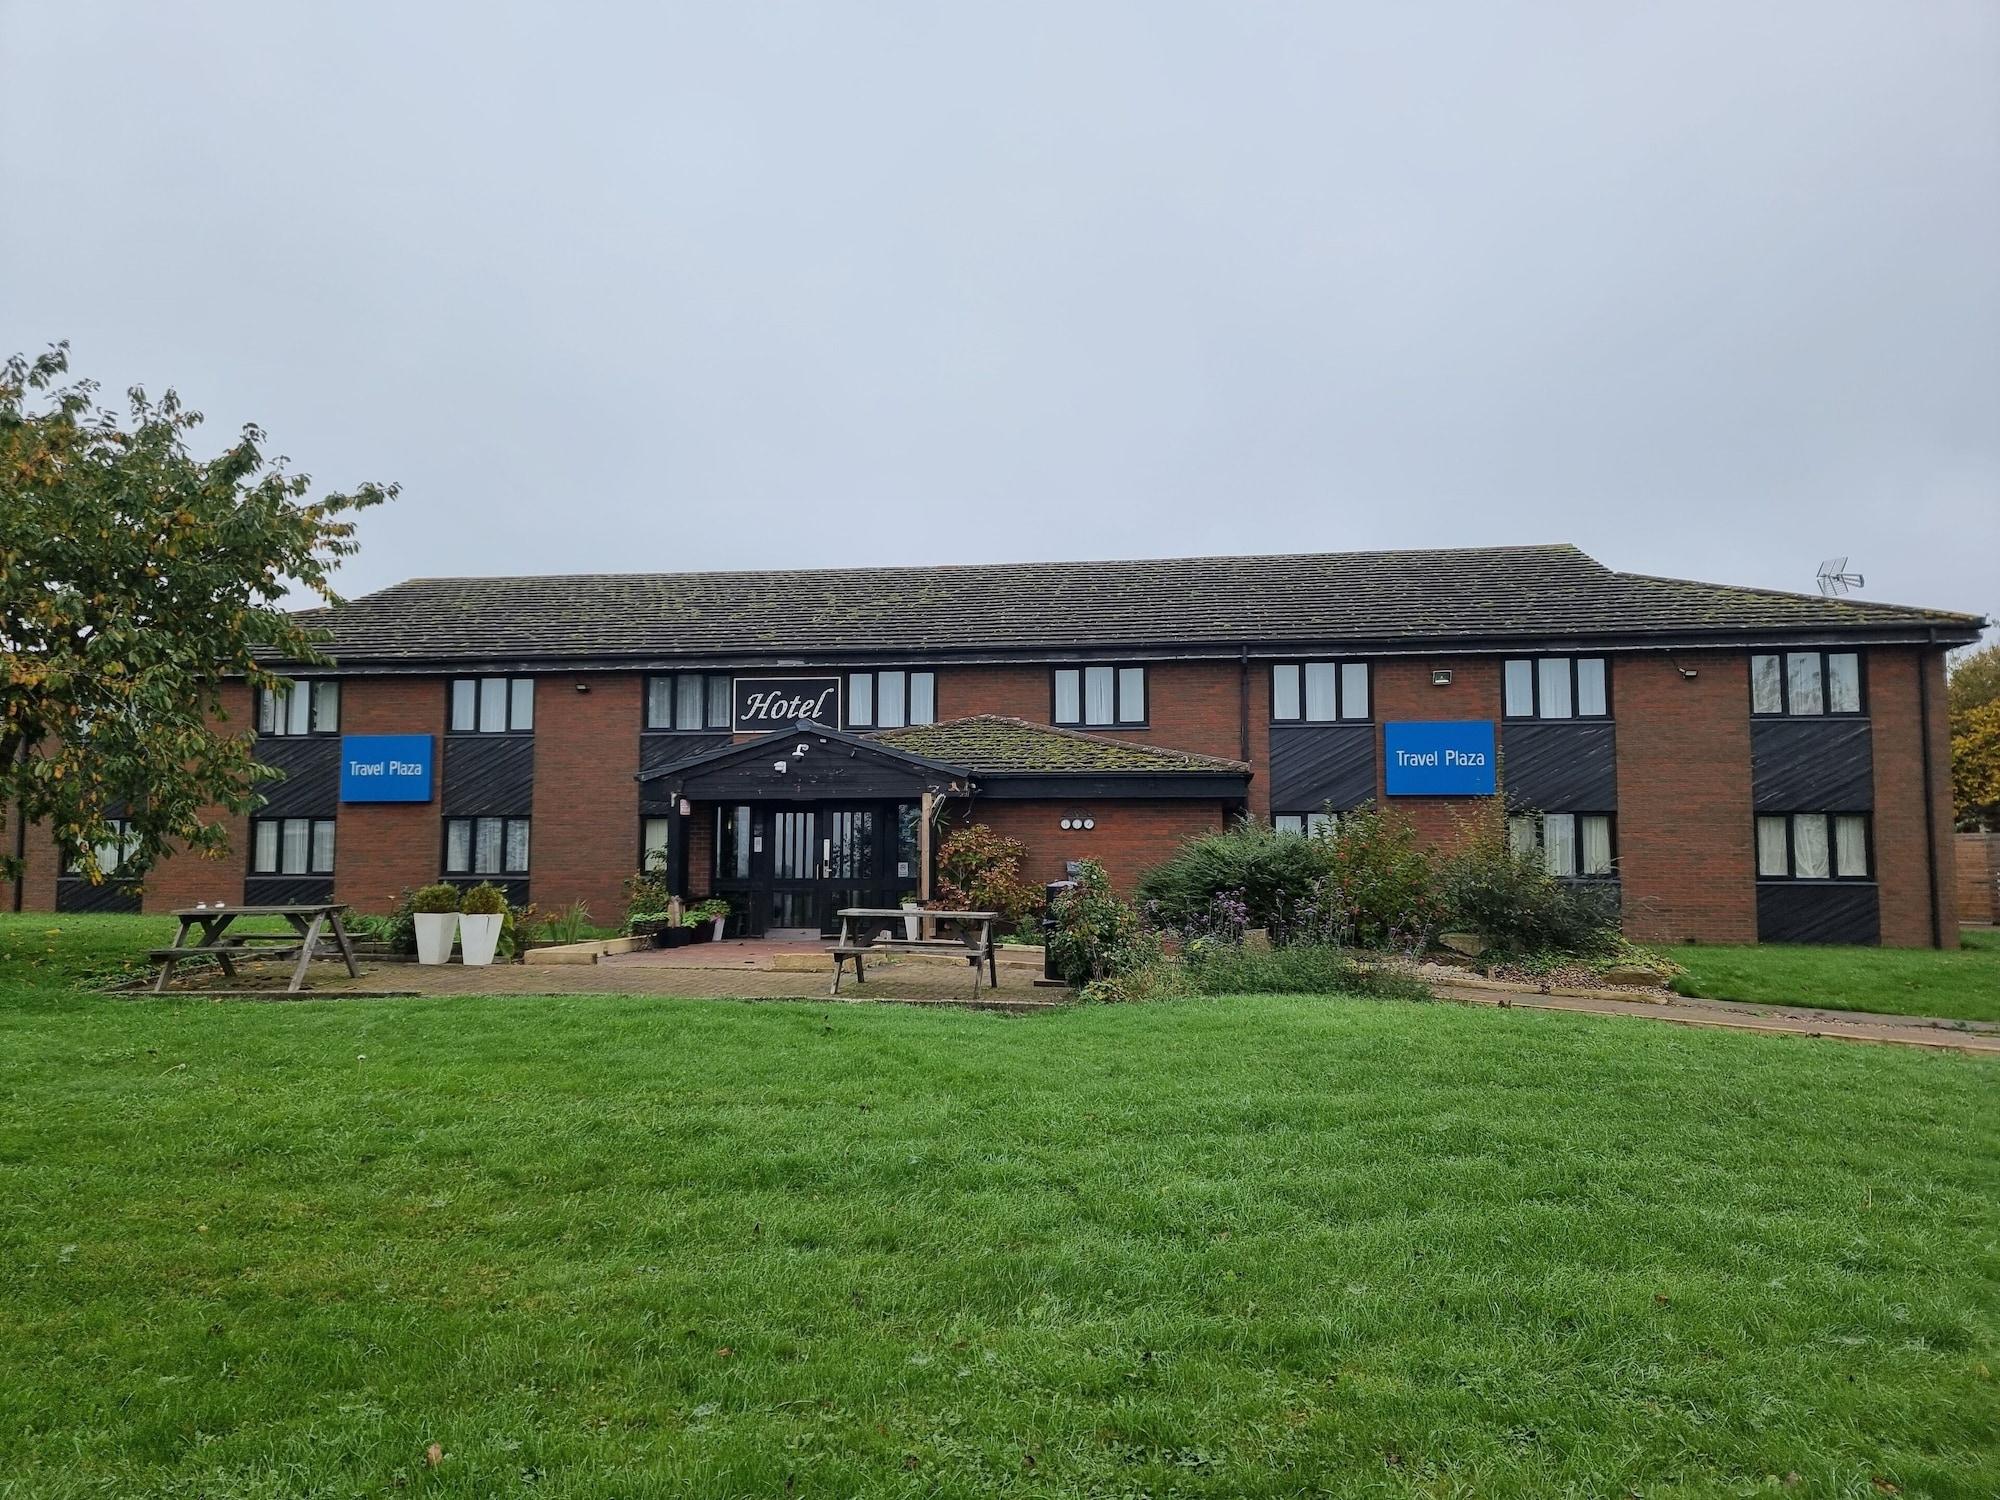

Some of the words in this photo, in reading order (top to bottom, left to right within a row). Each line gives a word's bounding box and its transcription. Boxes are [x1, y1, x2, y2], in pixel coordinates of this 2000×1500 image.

[741, 687, 834, 720] Hotel
[1396, 750, 1438, 766] Travel
[1445, 750, 1485, 766] Plaza
[350, 761, 385, 776] Travel
[389, 760, 422, 776] Plaza
